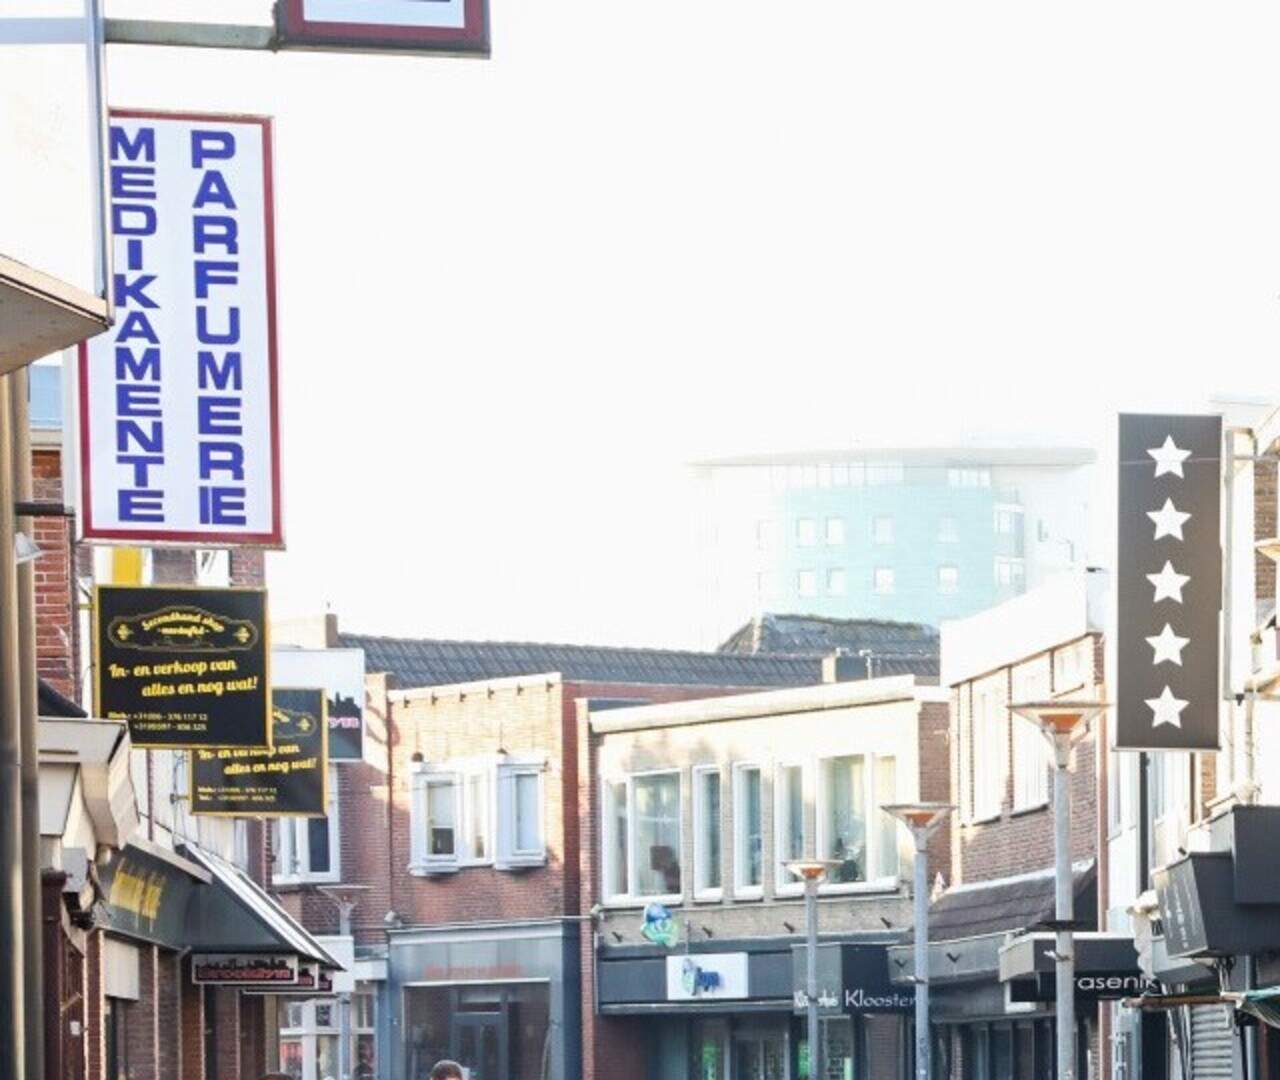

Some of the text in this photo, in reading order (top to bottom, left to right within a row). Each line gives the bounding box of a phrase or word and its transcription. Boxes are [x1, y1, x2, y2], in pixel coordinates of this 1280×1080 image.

[111, 126, 165, 523] MEDIKAMENTE
[190, 130, 247, 526] PARFUMERIE
[133, 666, 151, 677] en
[153, 661, 207, 676] verkoop
[210, 660, 237, 671] van
[142, 676, 258, 697] alles en nog wat!
